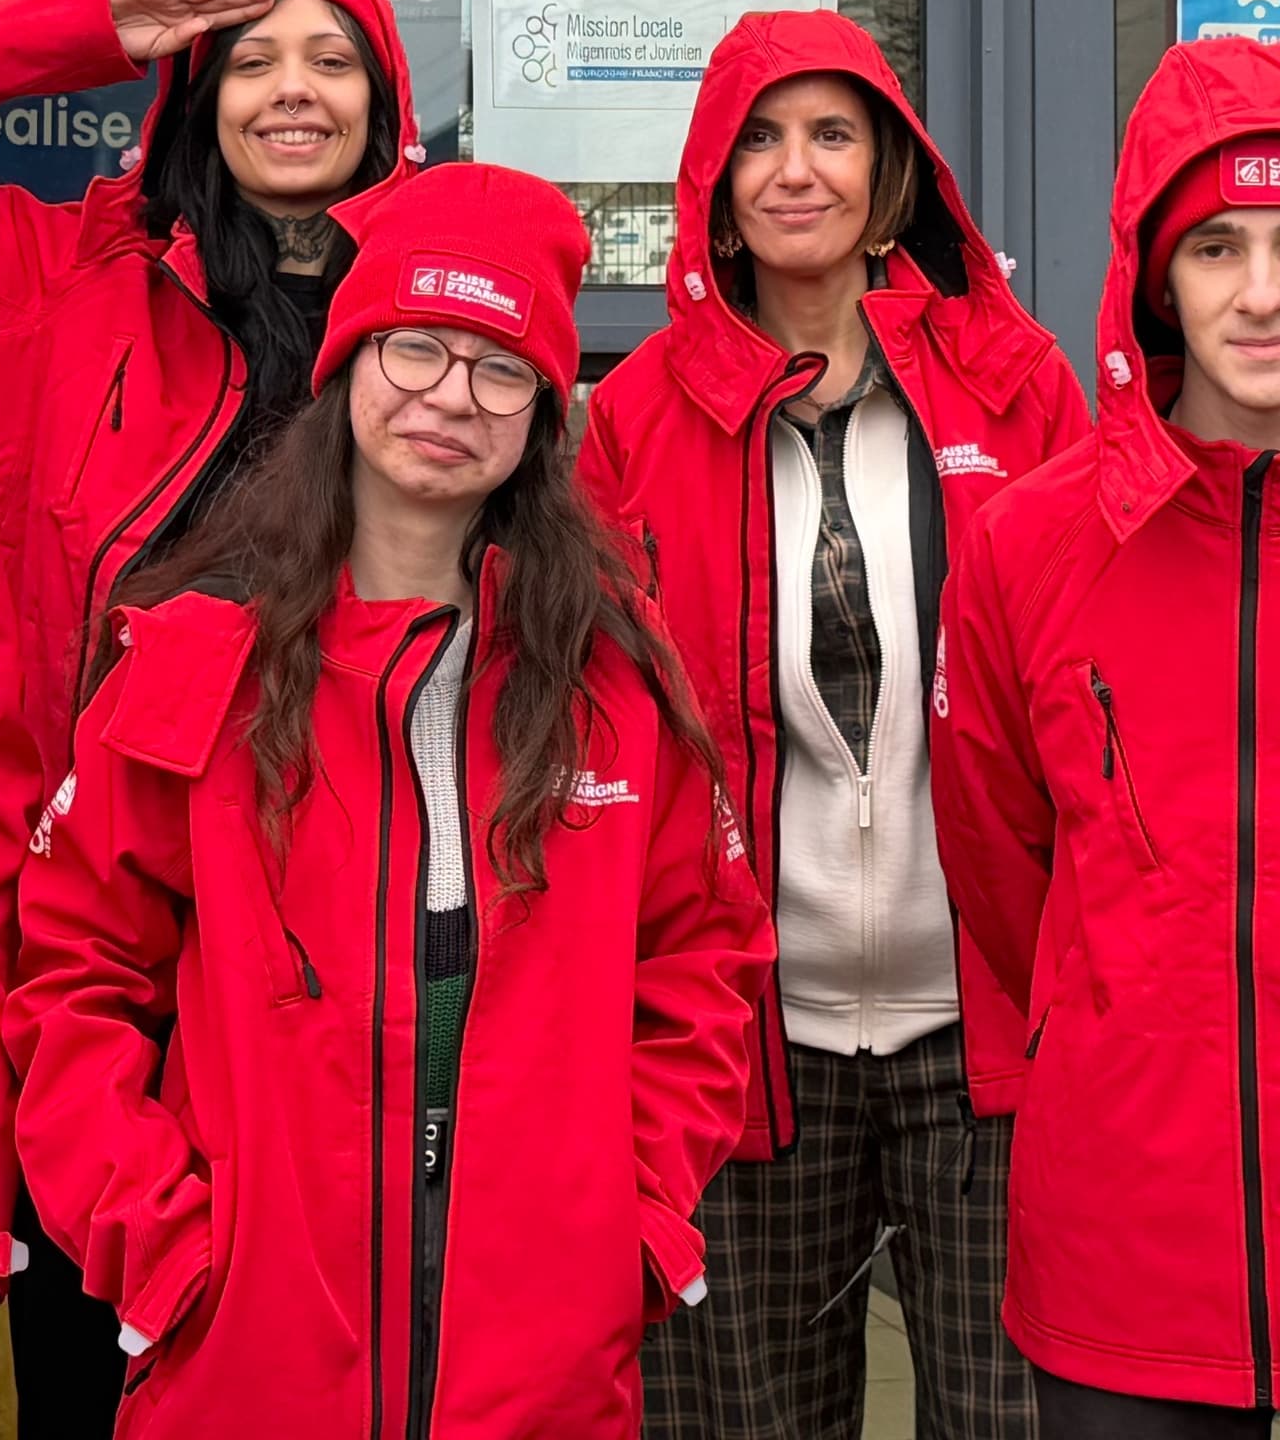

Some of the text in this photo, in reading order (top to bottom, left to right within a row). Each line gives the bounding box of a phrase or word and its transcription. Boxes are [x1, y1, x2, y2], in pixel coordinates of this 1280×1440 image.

[567, 14, 683, 38] Mission Locale
[567, 41, 702, 63] Migennois et Jovinien
[447, 271, 495, 290] CAISSE
[934, 443, 980, 460] CAISSE
